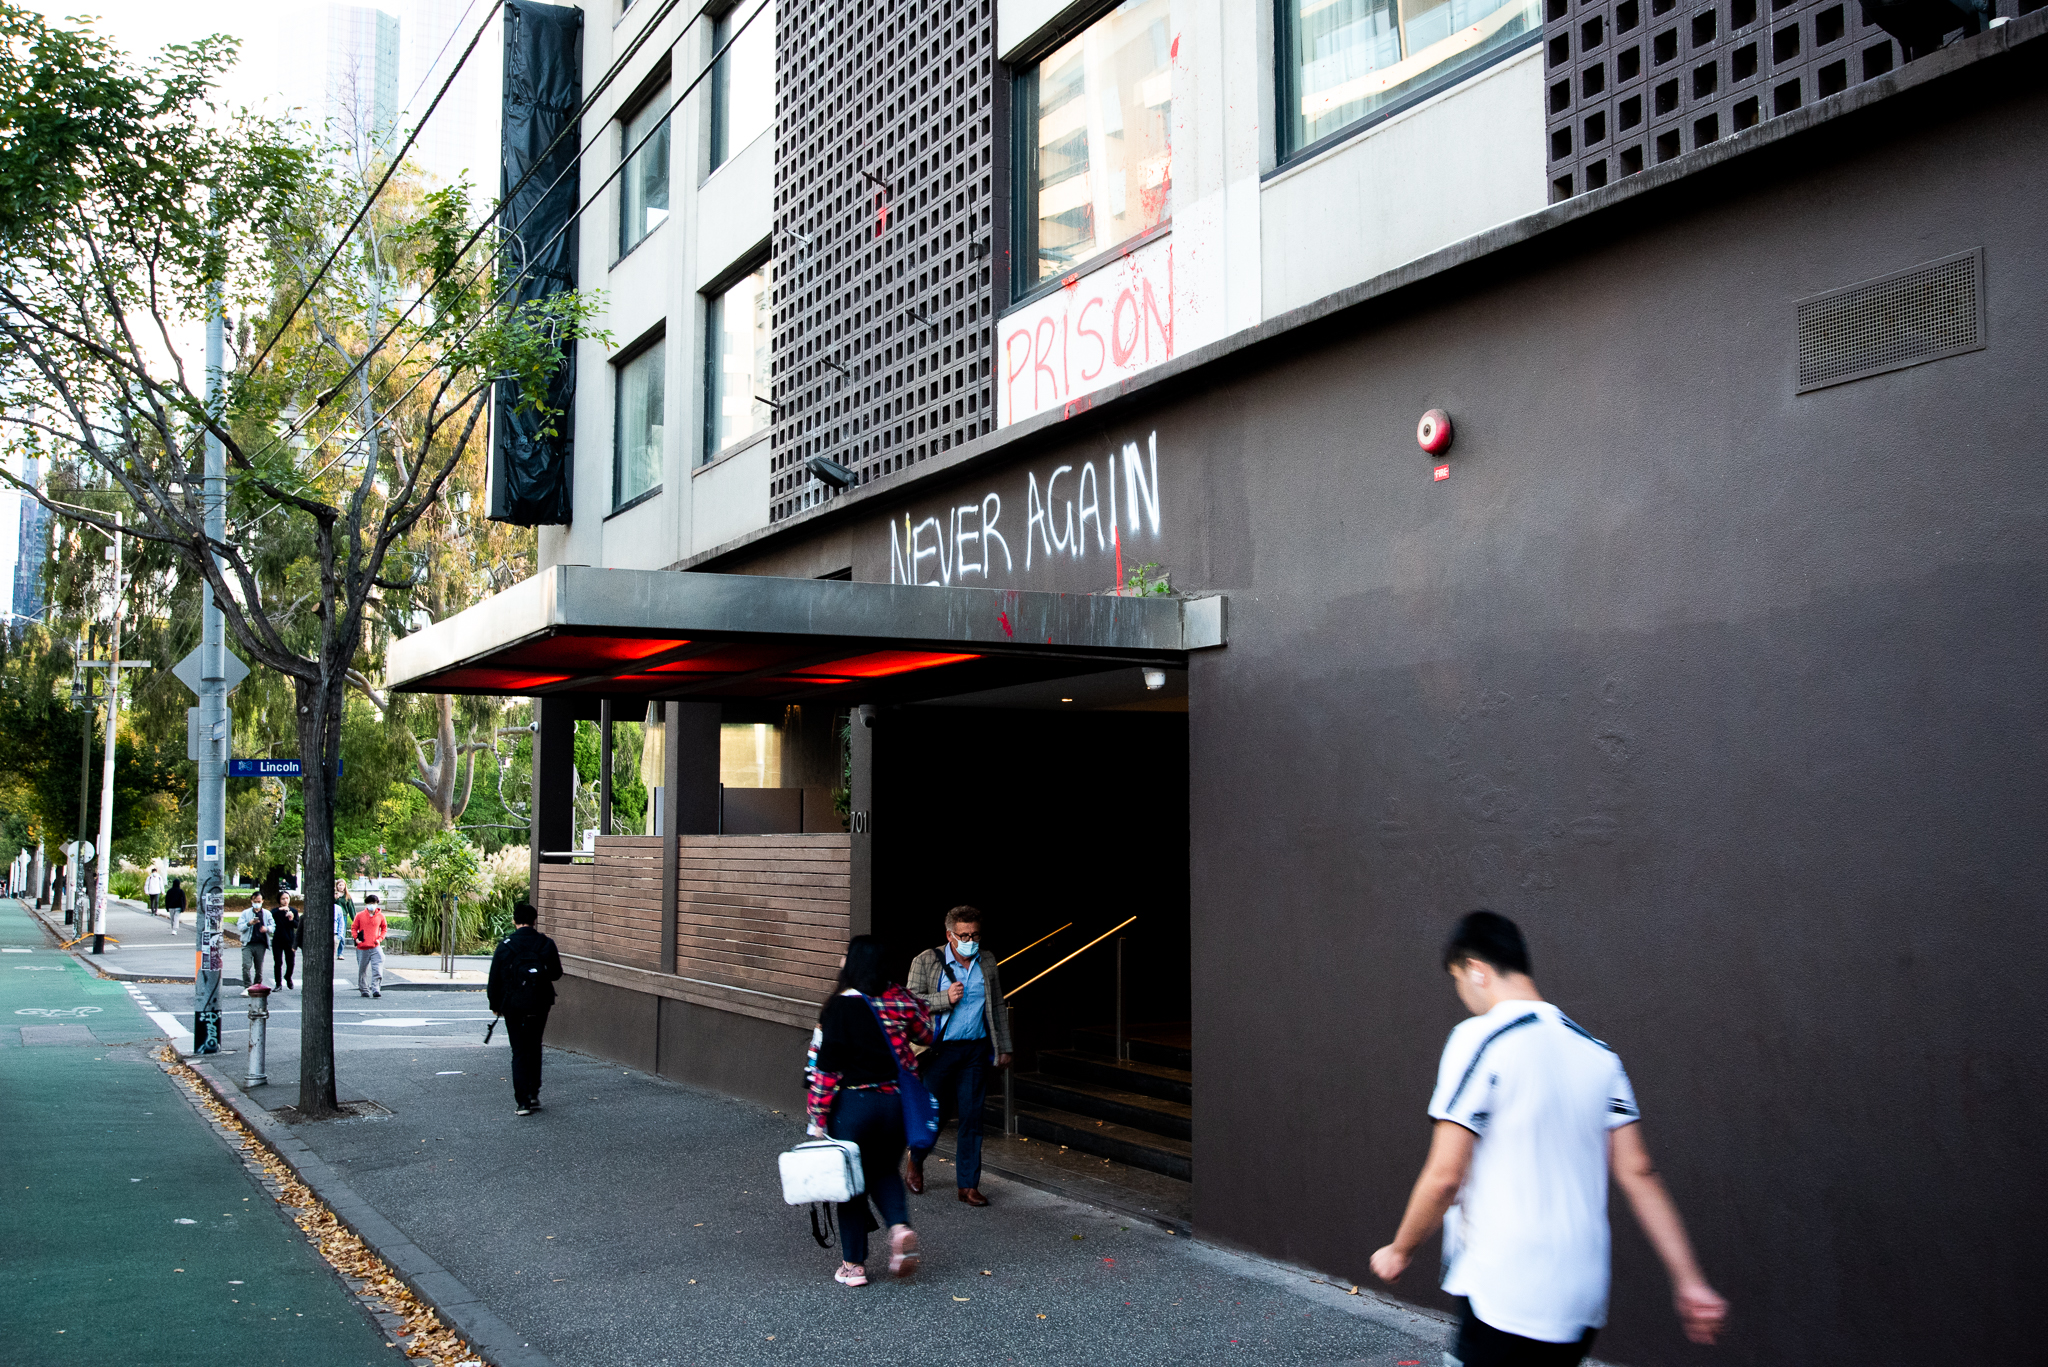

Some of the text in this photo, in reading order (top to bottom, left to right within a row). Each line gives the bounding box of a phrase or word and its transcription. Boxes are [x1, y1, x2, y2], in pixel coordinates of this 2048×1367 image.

[1006, 243, 1174, 425] PRISON
[1434, 467, 1449, 479] FIRE
[890, 430, 1161, 586] NEVER AGAIN
[260, 761, 299, 772] Lincoln
[850, 810, 868, 833] 701
